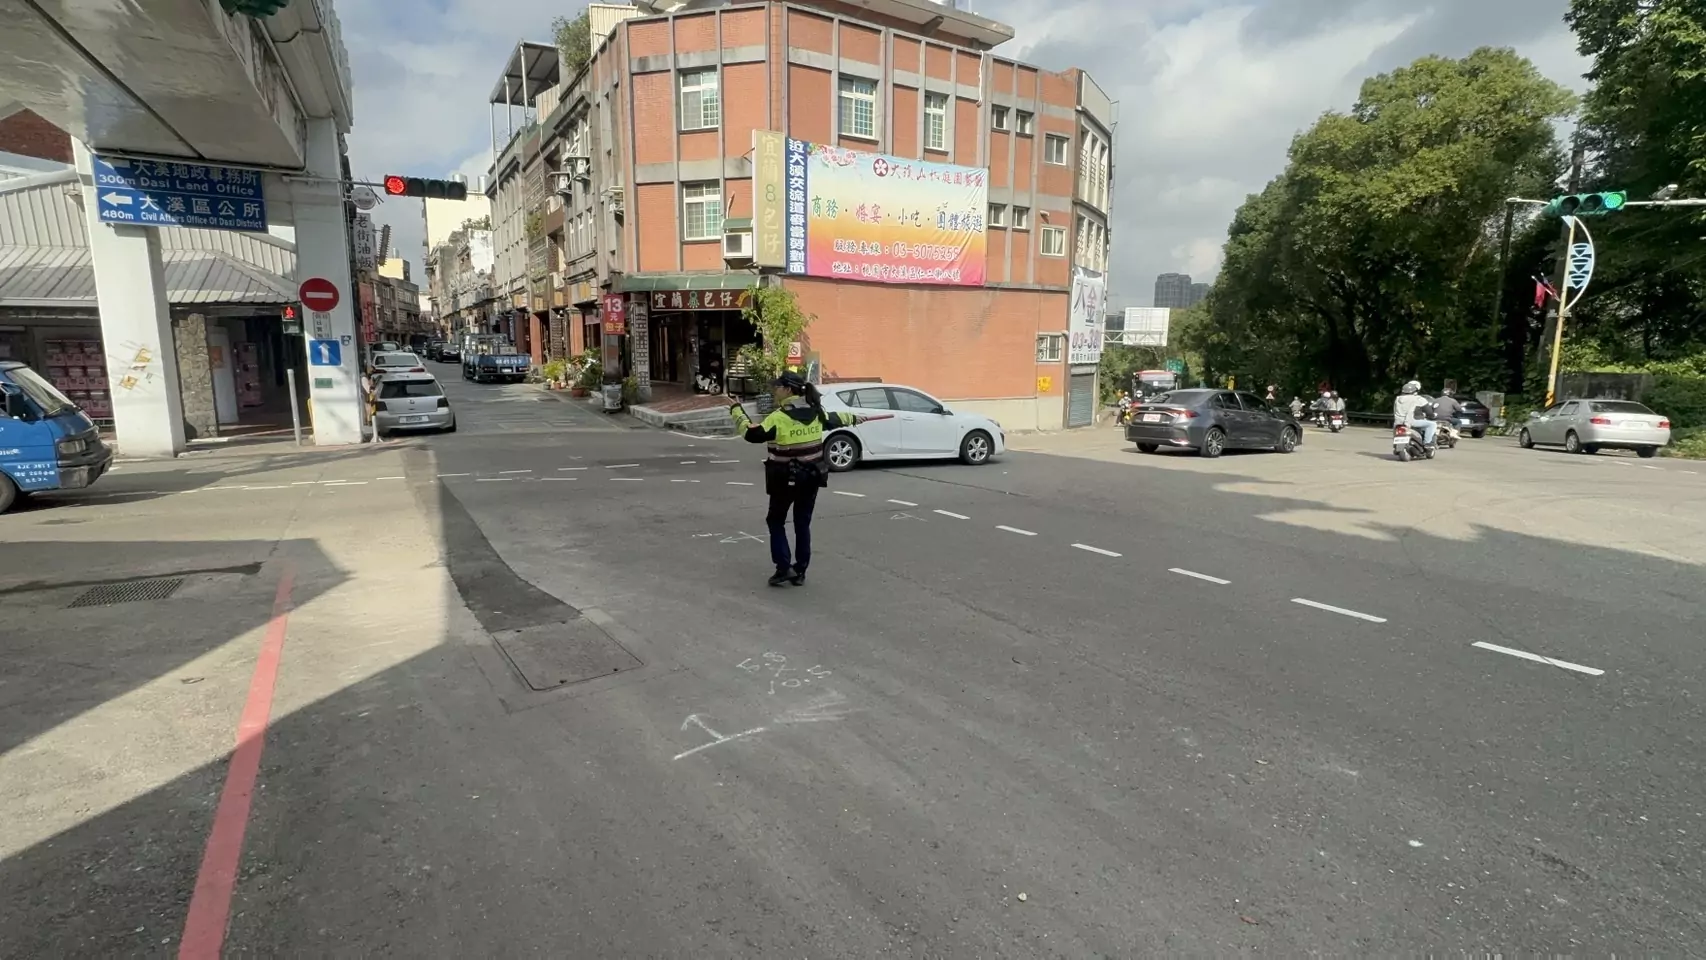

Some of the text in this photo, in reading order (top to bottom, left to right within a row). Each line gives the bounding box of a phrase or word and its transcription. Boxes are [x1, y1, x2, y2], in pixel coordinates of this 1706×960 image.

[133, 159, 257, 186] 大溪地政事務所
[99, 174, 254, 196] 300m Dasi Land Office
[139, 195, 261, 218] 大溪區公所
[102, 209, 134, 220] 480m
[141, 211, 158, 221] Civil
[604, 298, 622, 312] 13
[610, 312, 618, 321] 元
[605, 322, 624, 332] 包子
[789, 426, 820, 438] POLICE
